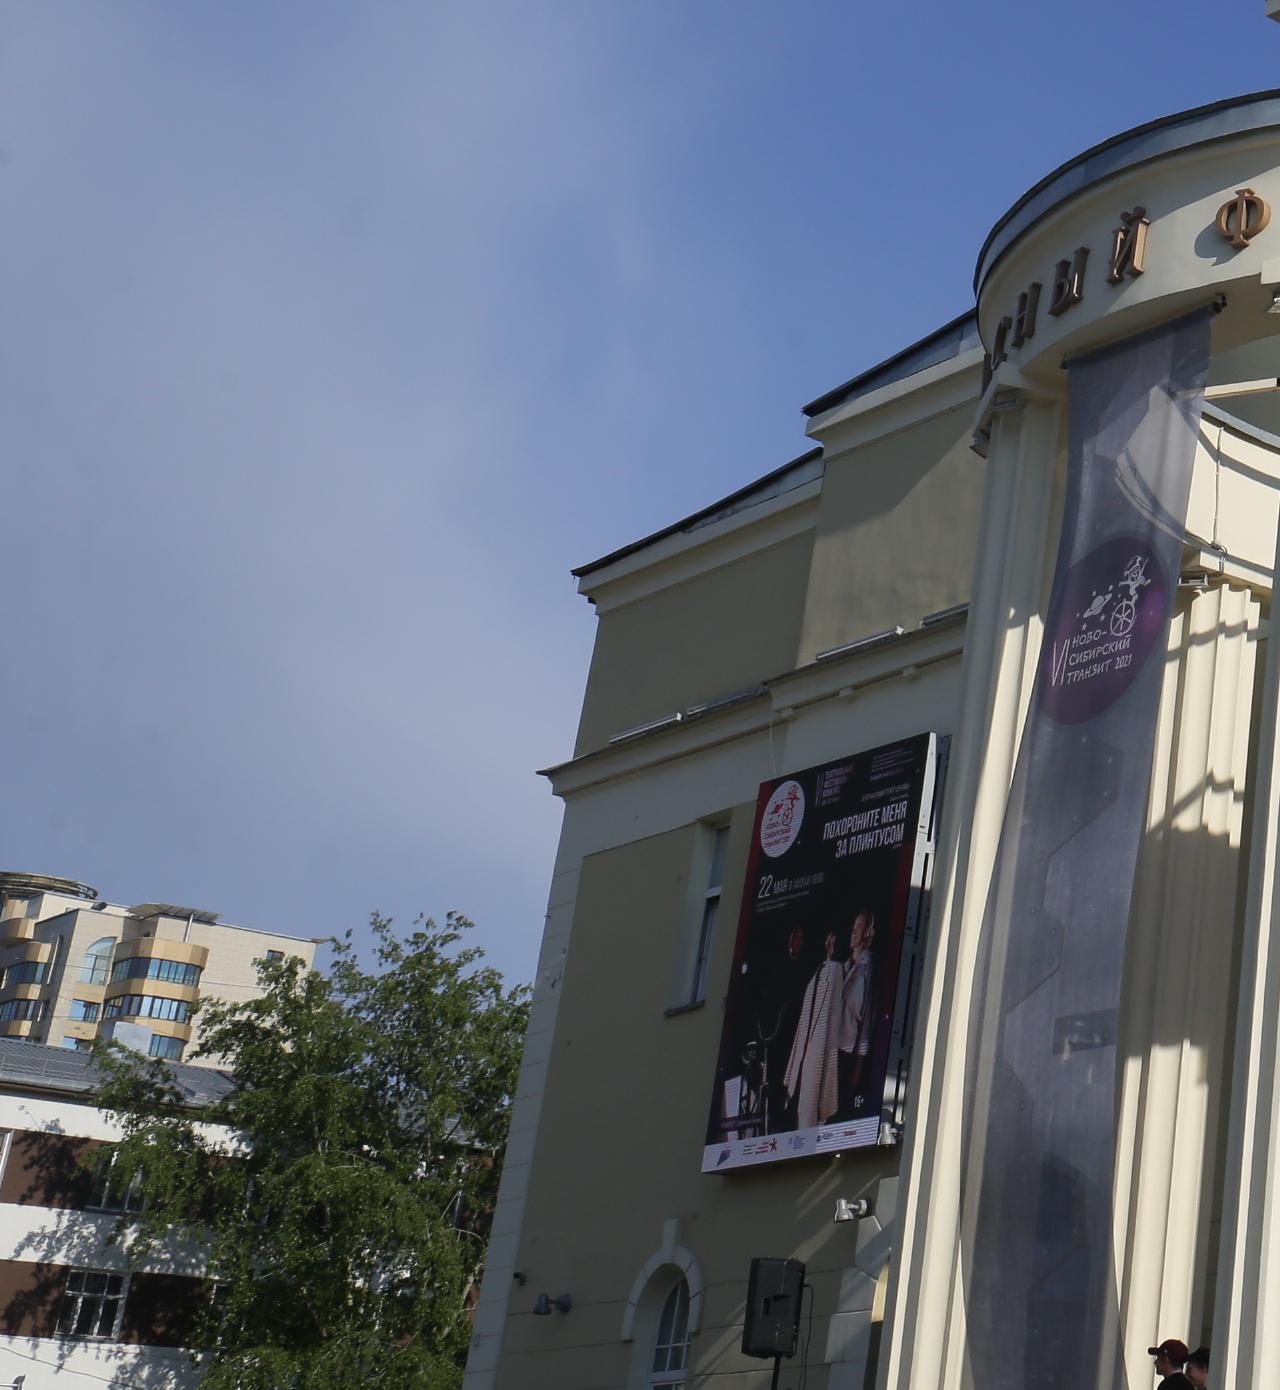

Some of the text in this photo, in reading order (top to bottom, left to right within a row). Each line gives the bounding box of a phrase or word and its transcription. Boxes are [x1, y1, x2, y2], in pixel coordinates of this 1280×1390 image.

[982, 206, 1151, 396] СНЫЙ
[1069, 634, 1131, 666] СИБИРСКИЙ
[1072, 630, 1107, 648] НОВО-
[1066, 654, 1133, 685] ТРАНЗИТ 2021
[823, 800, 908, 841] ПОХОРОНИТЕ МЕНЯ
[836, 823, 905, 859] ЗА ПЛИНТУСОМ
[758, 874, 773, 899] 22
